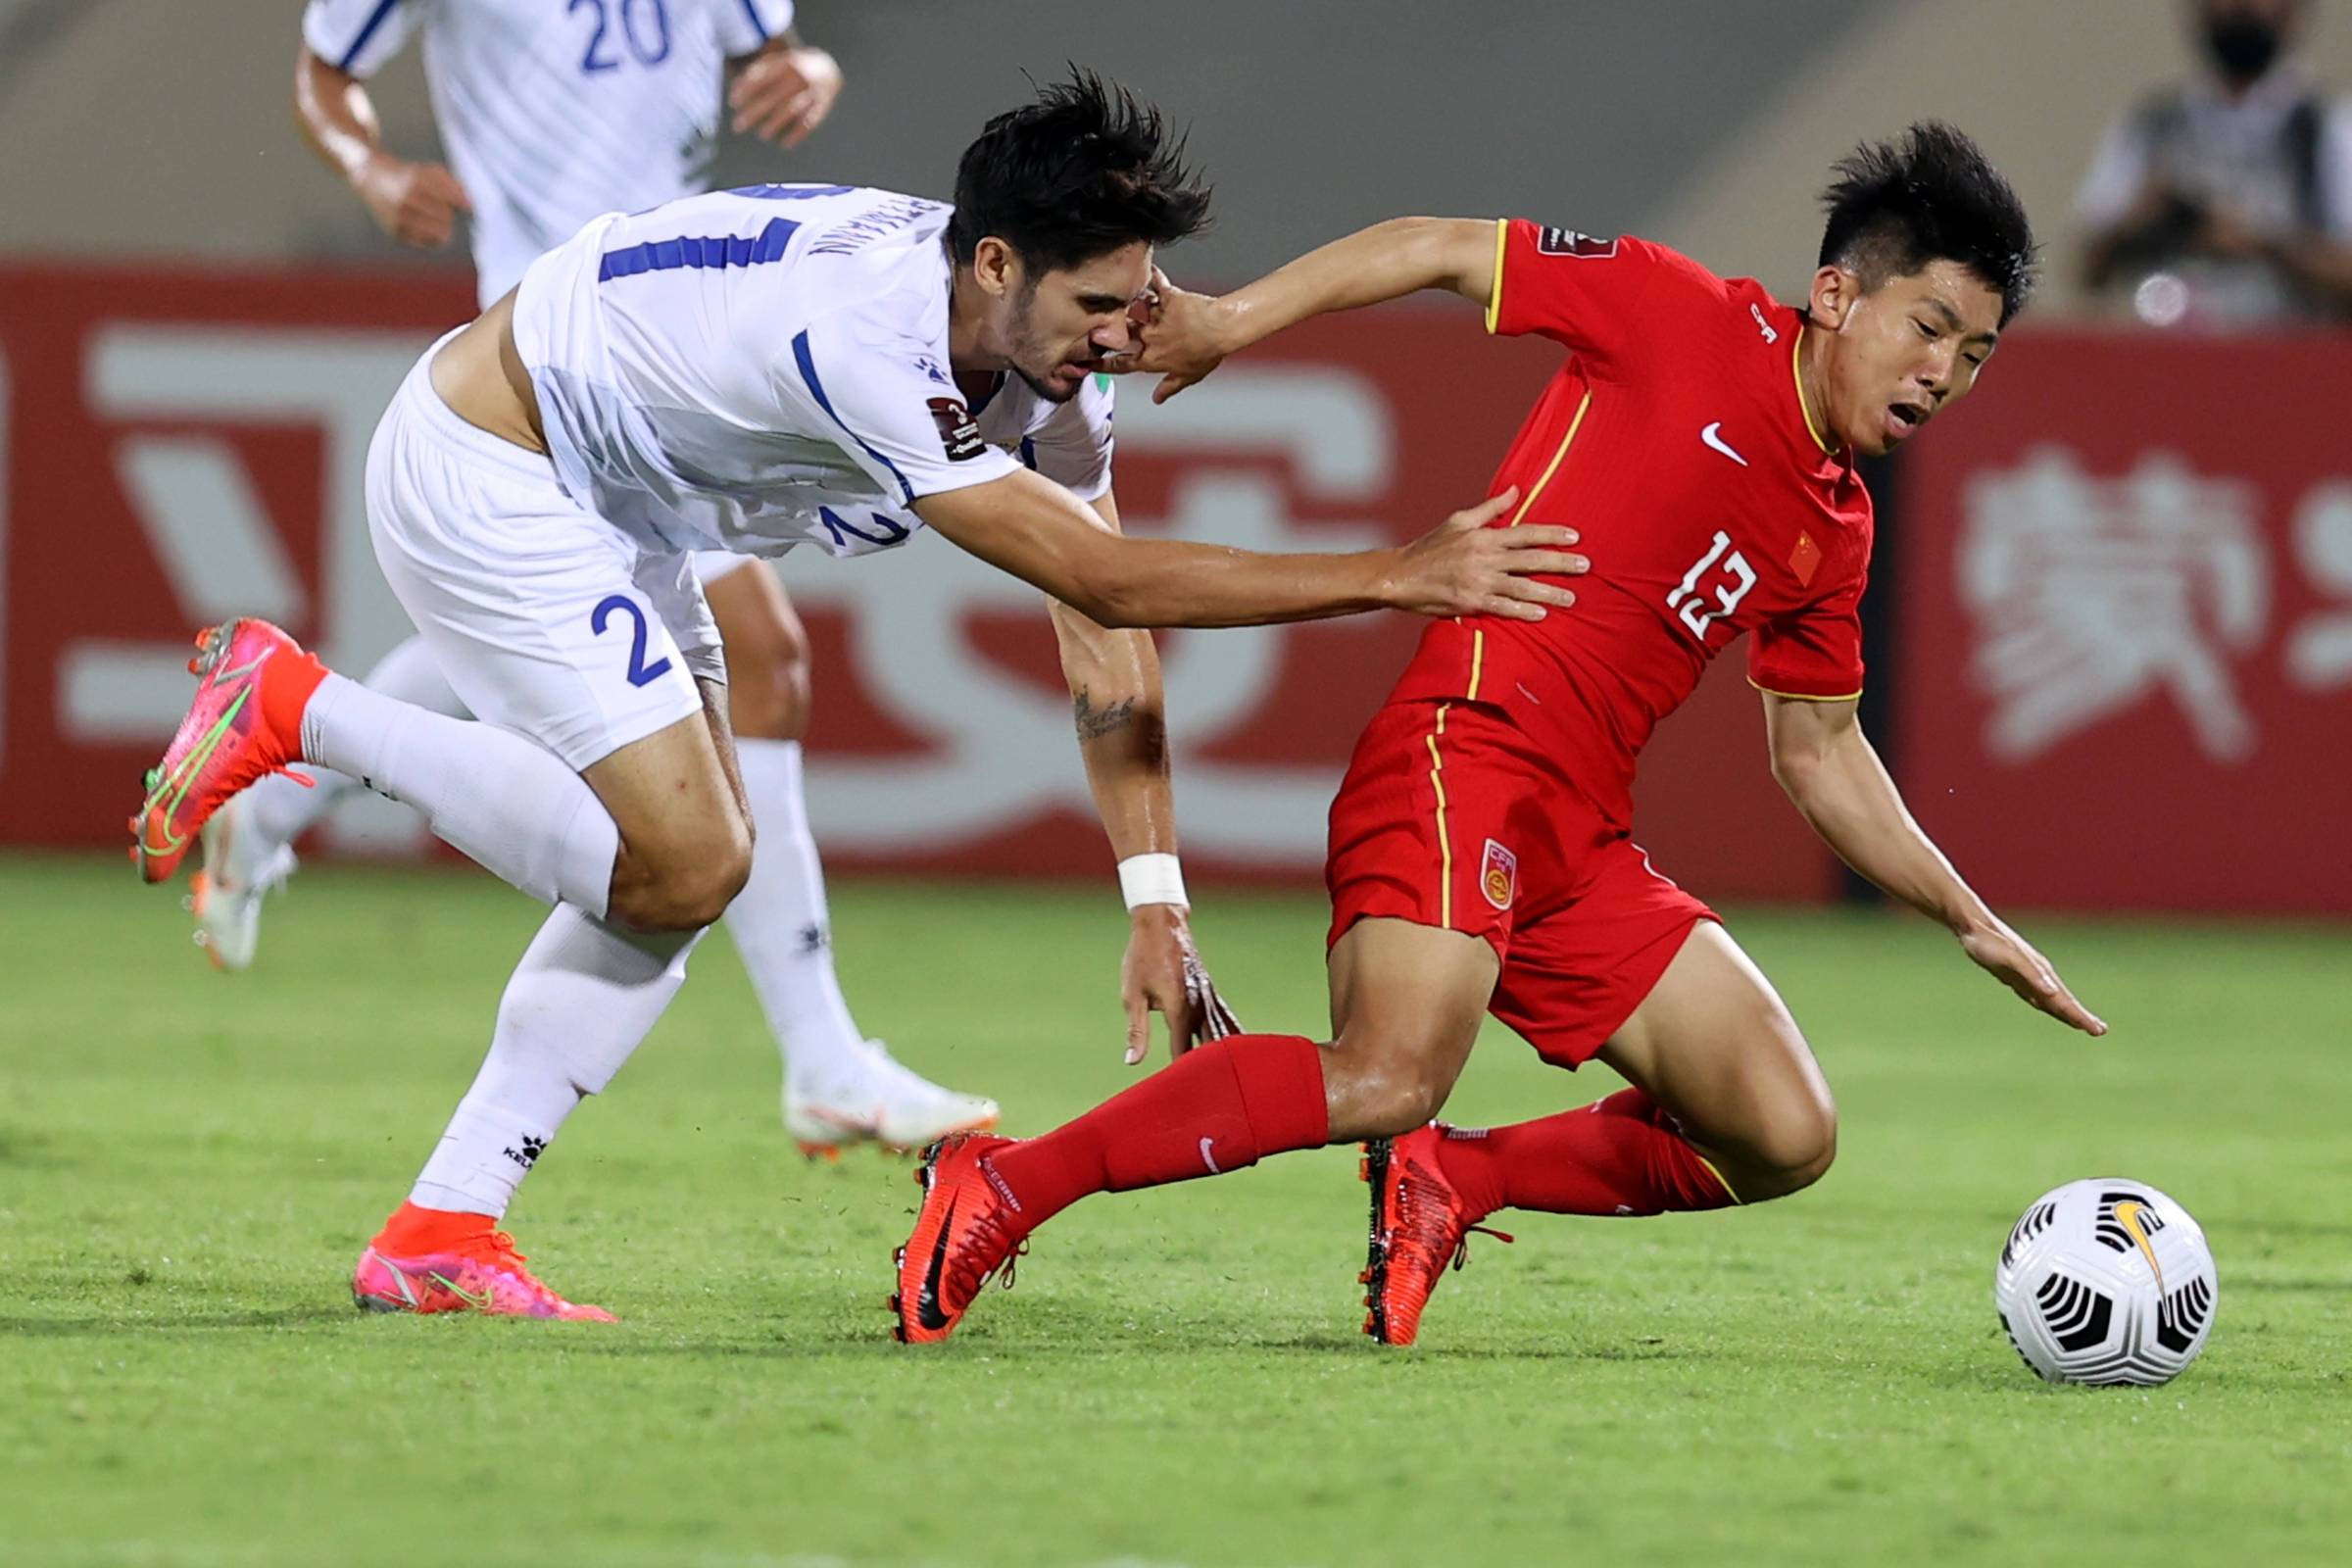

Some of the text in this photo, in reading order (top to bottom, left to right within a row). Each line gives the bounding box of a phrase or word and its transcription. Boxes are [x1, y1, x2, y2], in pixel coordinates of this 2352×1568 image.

[567, 0, 670, 74] 20
[818, 506, 925, 547] 2
[1665, 529, 1758, 641] 13
[591, 594, 673, 689] 2
